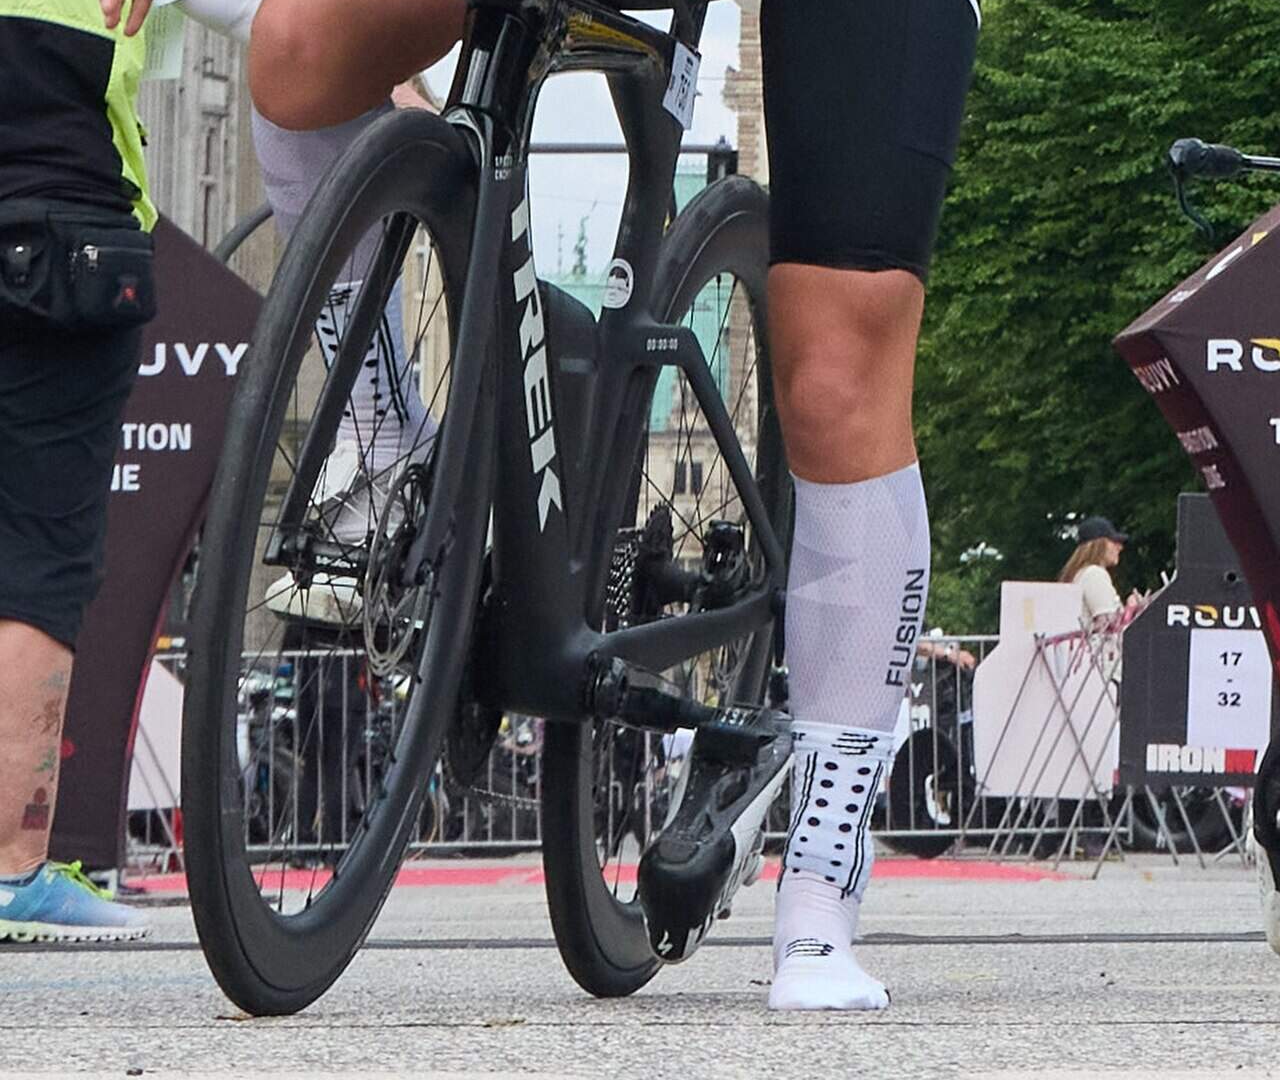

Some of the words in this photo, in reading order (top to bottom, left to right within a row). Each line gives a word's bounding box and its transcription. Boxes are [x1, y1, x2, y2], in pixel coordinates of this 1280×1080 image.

[511, 197, 564, 535] TREK
[121, 422, 192, 451] TION
[885, 568, 925, 687] FUSION
[1219, 651, 1243, 667] 17
[1217, 691, 1241, 707] 32
